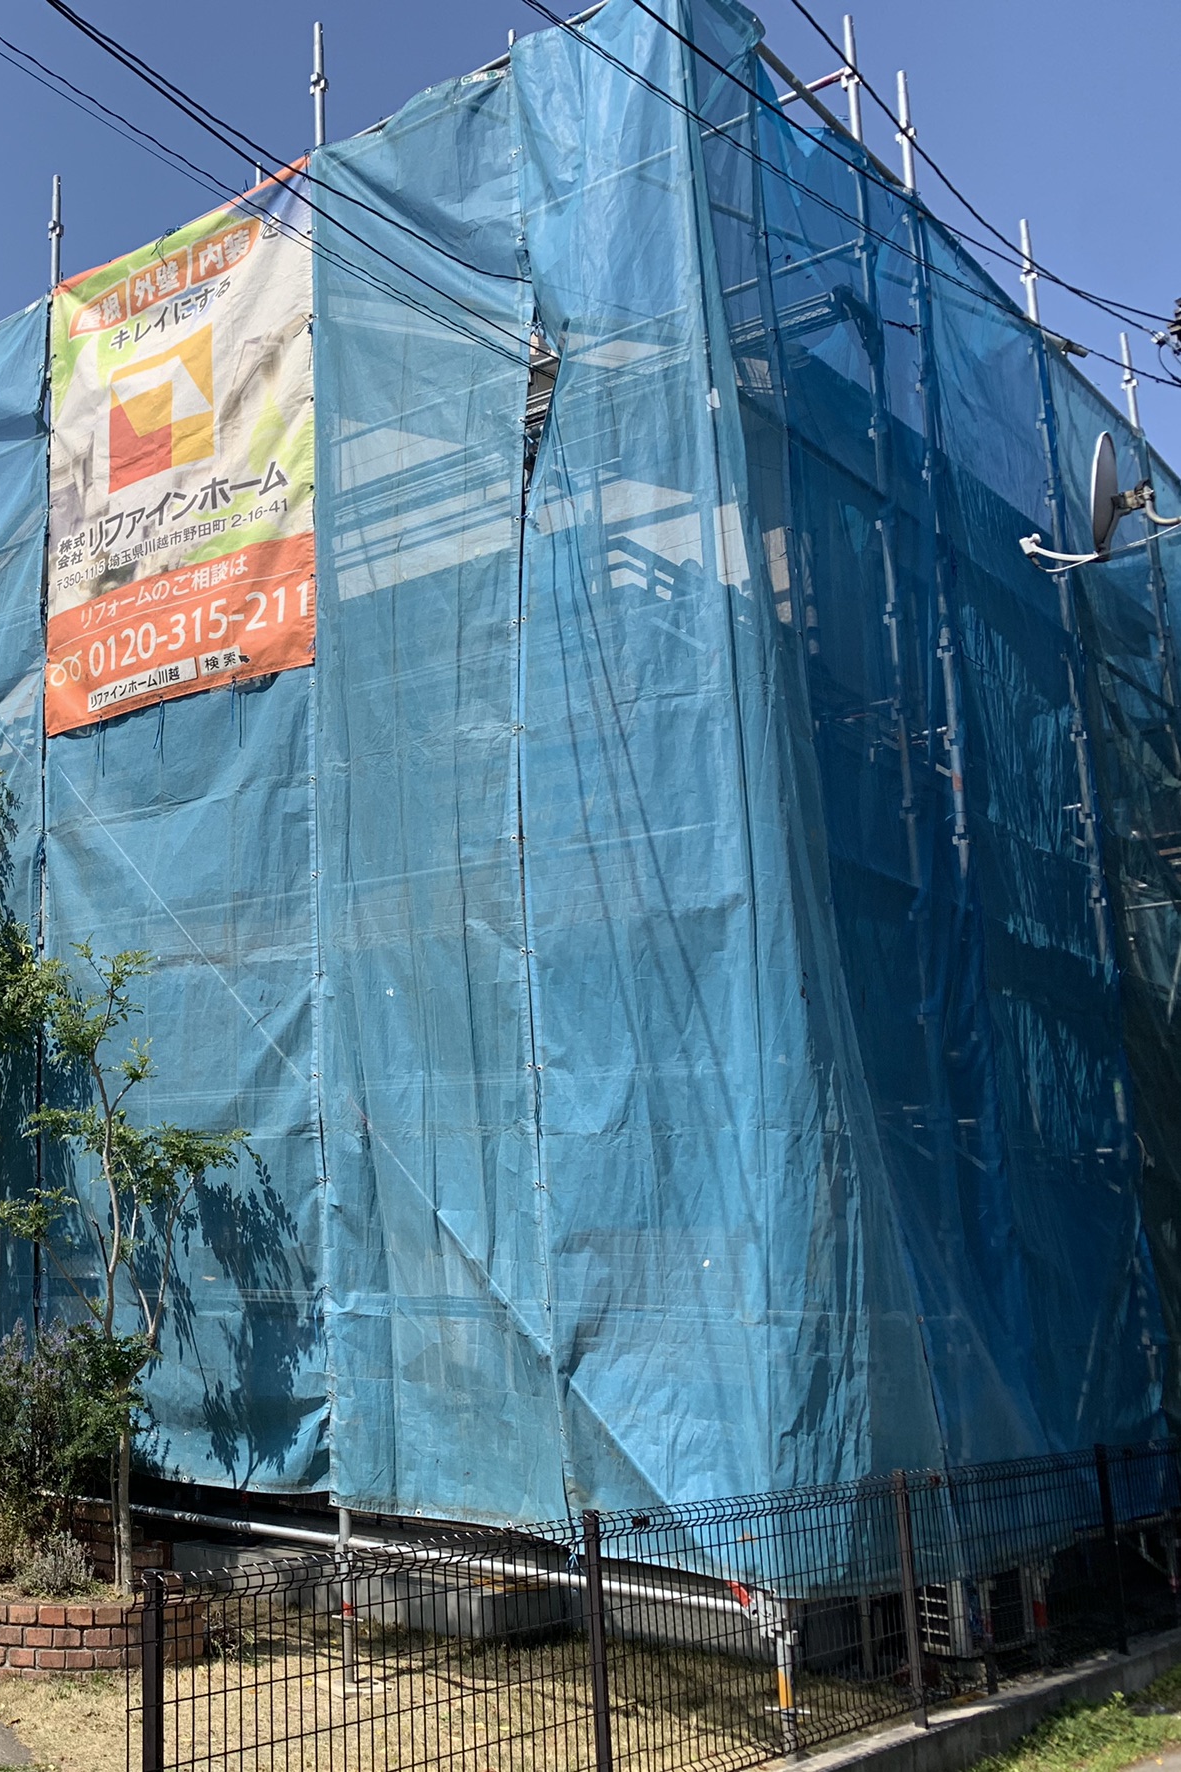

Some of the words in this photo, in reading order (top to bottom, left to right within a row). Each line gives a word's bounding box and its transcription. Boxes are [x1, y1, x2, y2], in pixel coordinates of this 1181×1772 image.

[134, 263, 180, 308] 外壁
[198, 227, 250, 276] 内装
[110, 276, 232, 352] キレイにする
[58, 534, 87, 556] 株式
[88, 461, 290, 556] リファインホーム
[108, 516, 227, 571] 埼玉県川越市野田町
[231, 497, 290, 529] 2-16-41
[57, 550, 84, 571] 会社
[81, 554, 249, 630] リフォームのご相談は
[88, 580, 310, 678] 0120-315-211
[90, 665, 180, 708] リファインホーム川越
[205, 652, 237, 671] 検索
